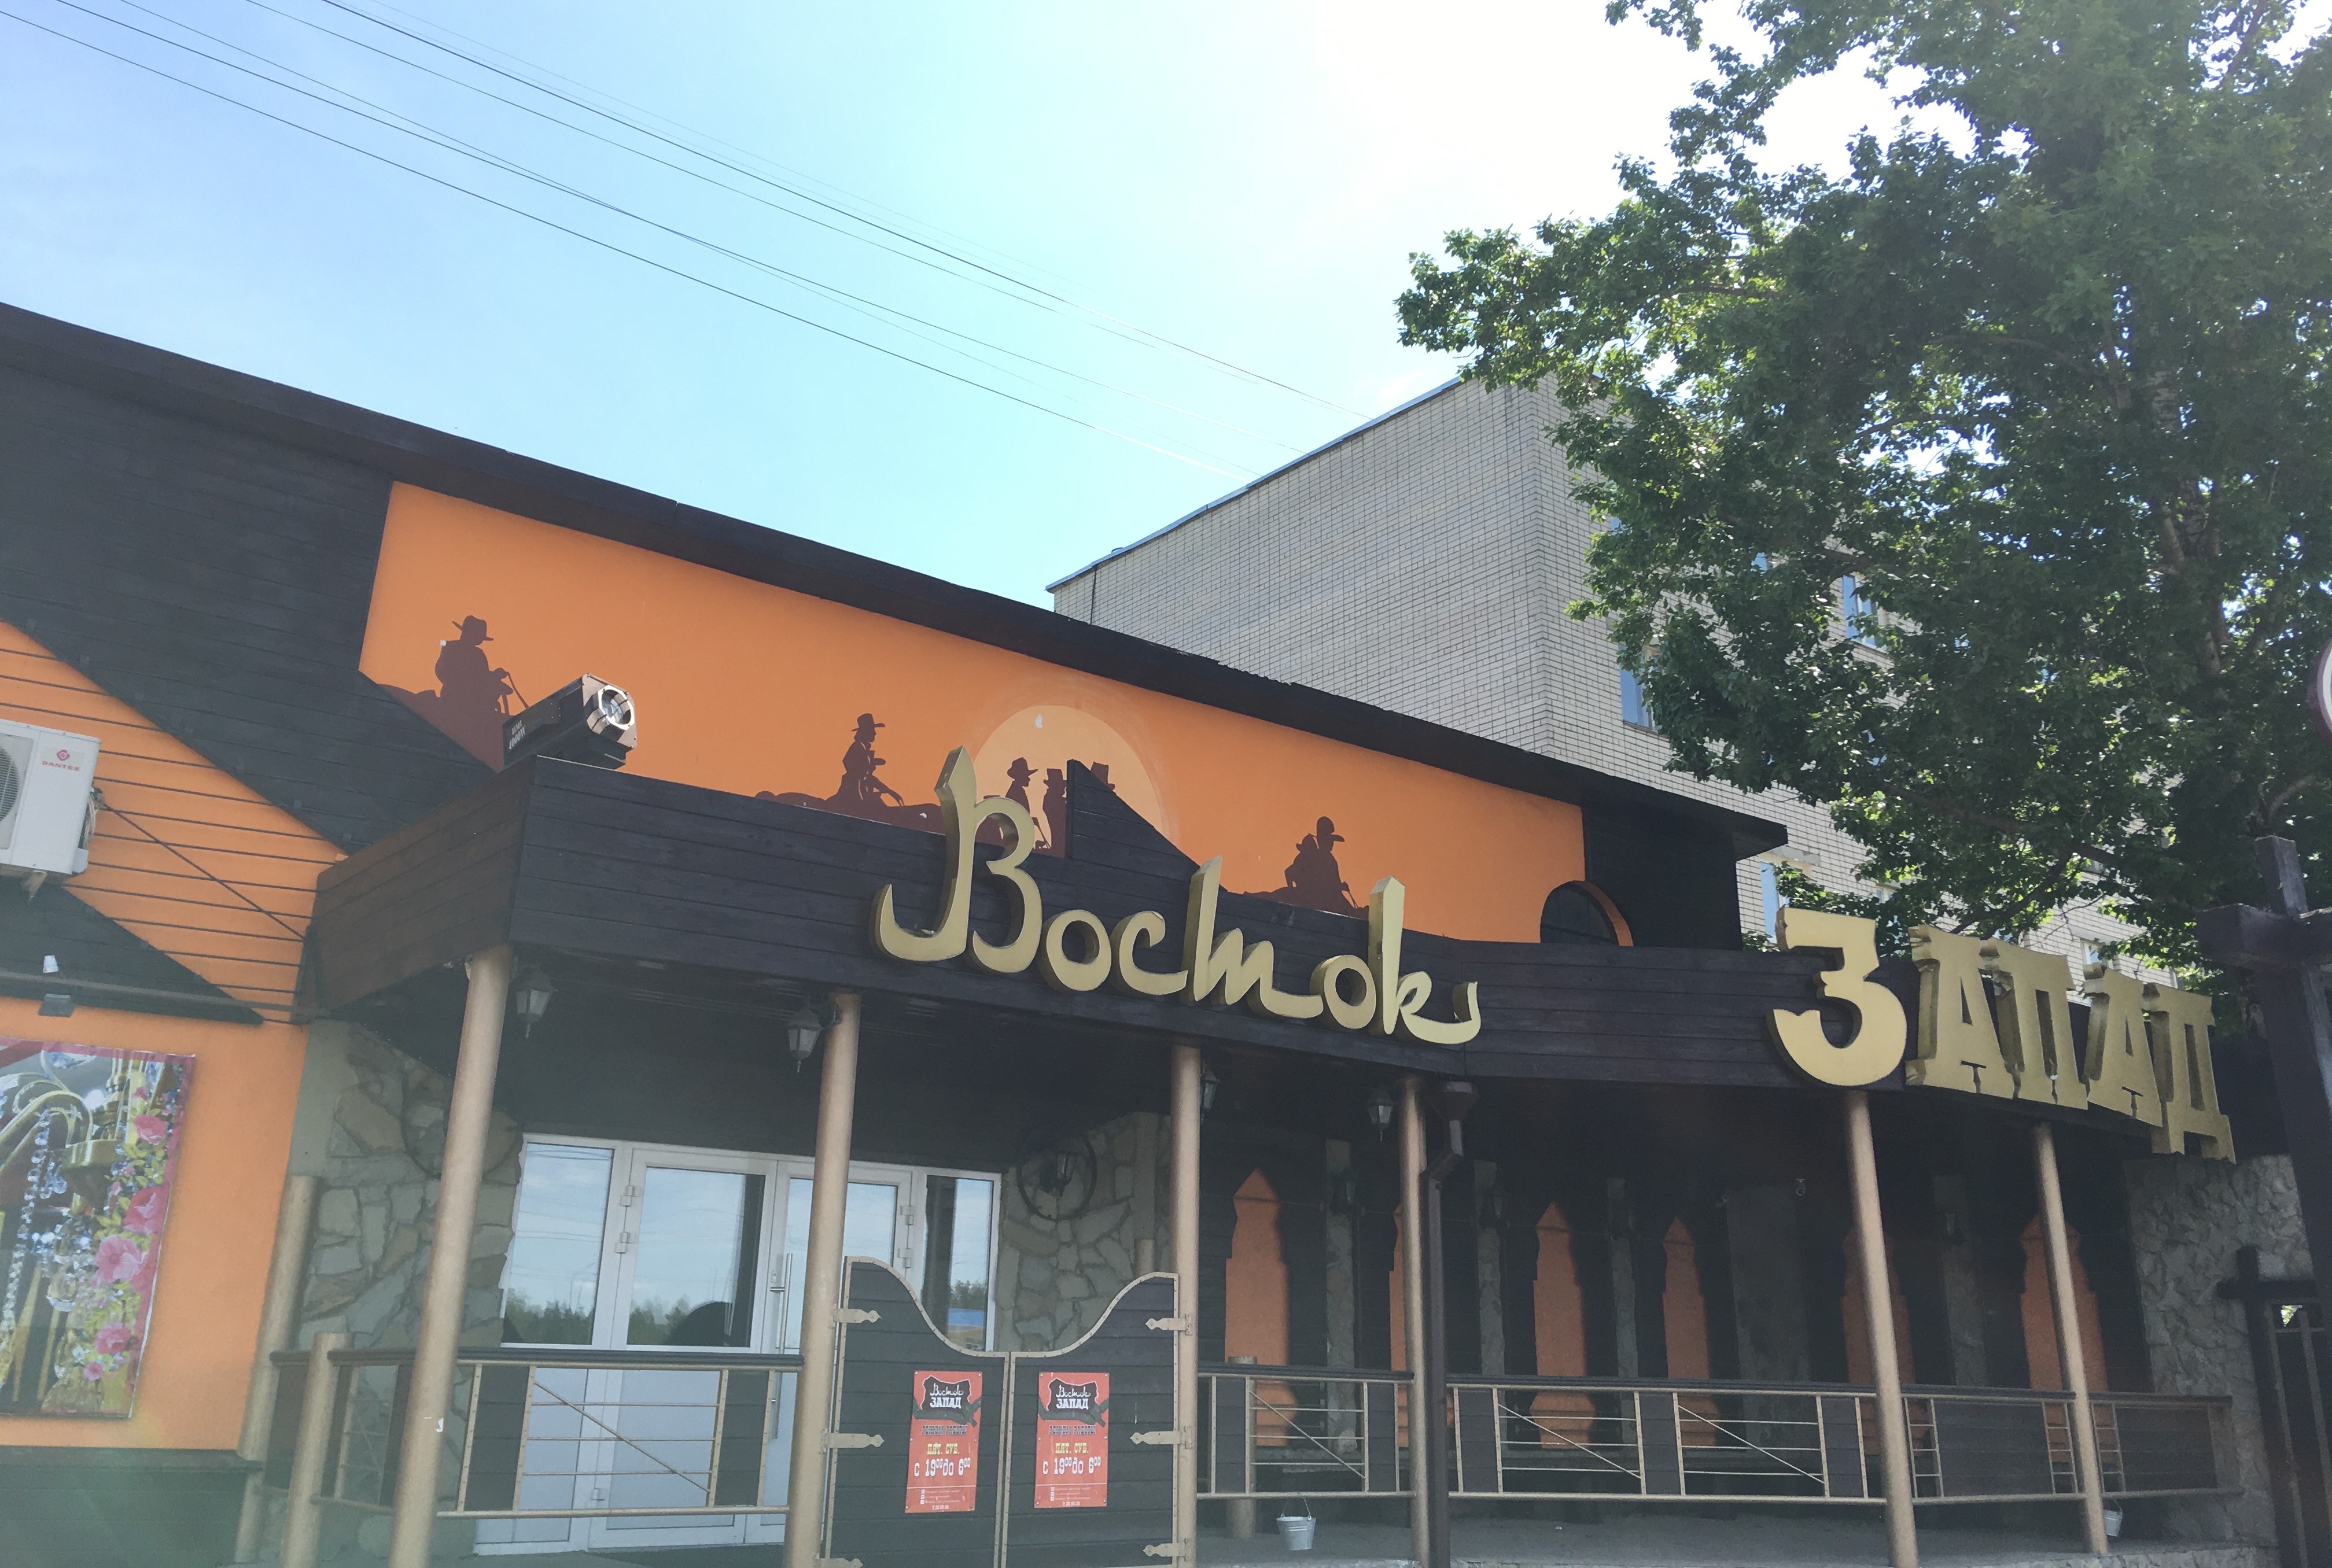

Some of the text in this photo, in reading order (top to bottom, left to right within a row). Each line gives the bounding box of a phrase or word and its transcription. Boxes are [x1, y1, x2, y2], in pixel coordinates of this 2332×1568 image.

[42, 761, 80, 771] DANTEX
[870, 746, 1481, 1045] Восток
[1766, 905, 2237, 1164] ЗАПАД
[930, 1396, 962, 1409] ЗАПАД
[1056, 1398, 1089, 1410] ЗАПАД
